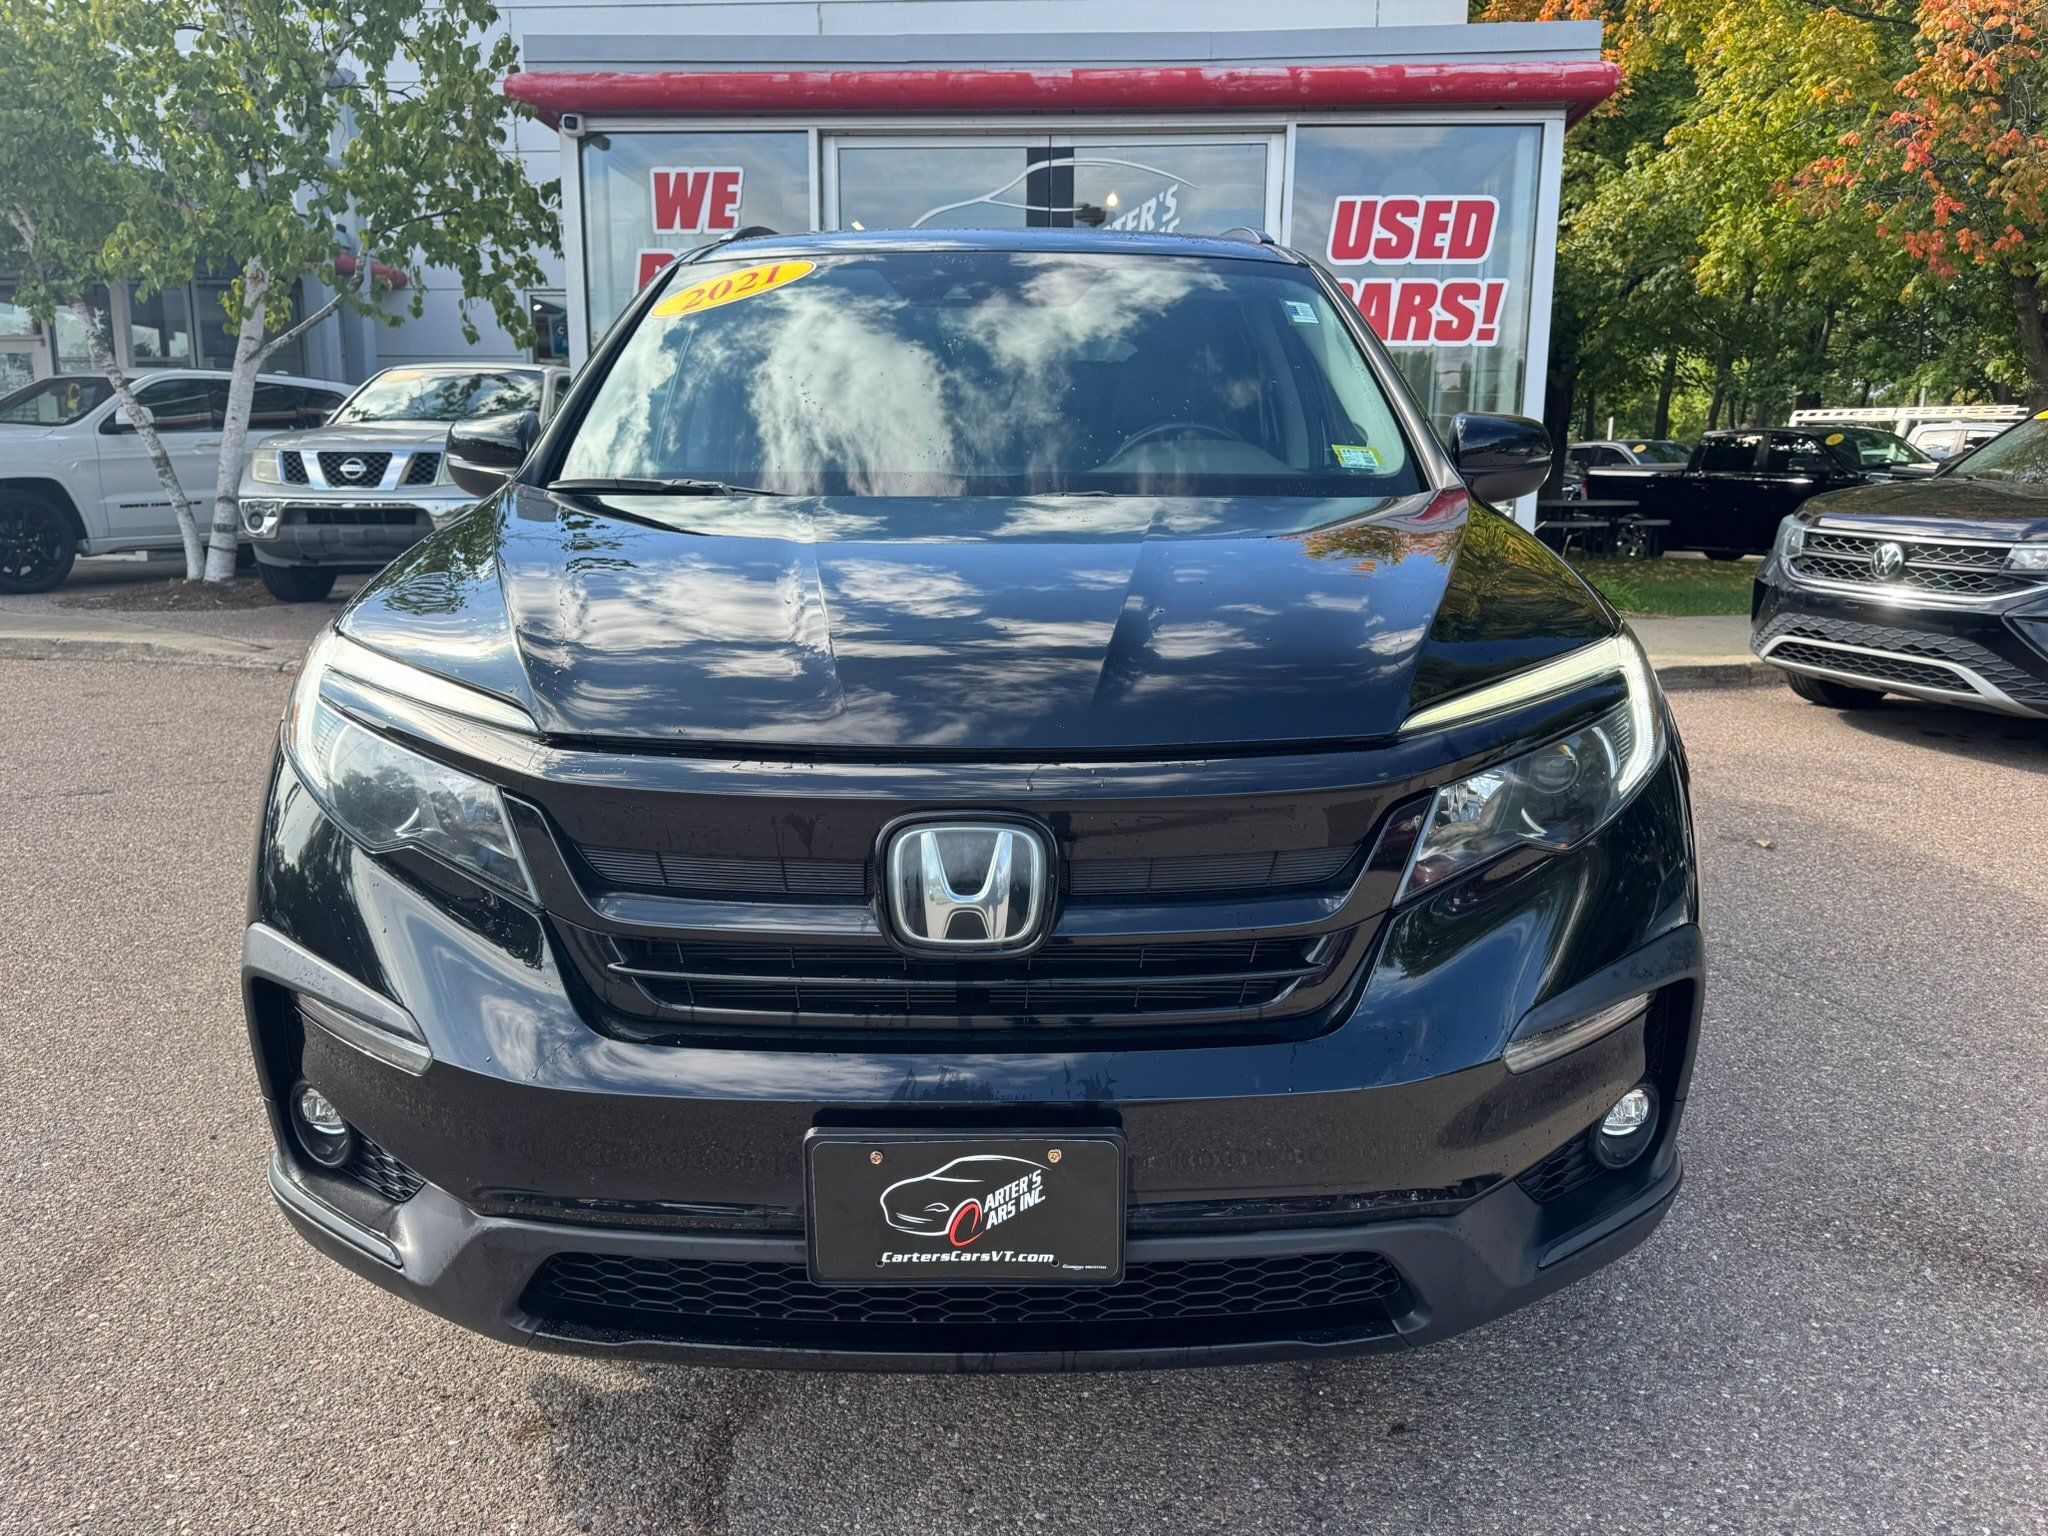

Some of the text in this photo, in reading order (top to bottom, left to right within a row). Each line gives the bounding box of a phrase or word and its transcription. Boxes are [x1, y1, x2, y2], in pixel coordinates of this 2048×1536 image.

[651, 168, 743, 233] WE
[1328, 197, 1498, 264] USED
[680, 264, 781, 311] 2021
[881, 1251, 1054, 1263] CartersCarsVT.com
